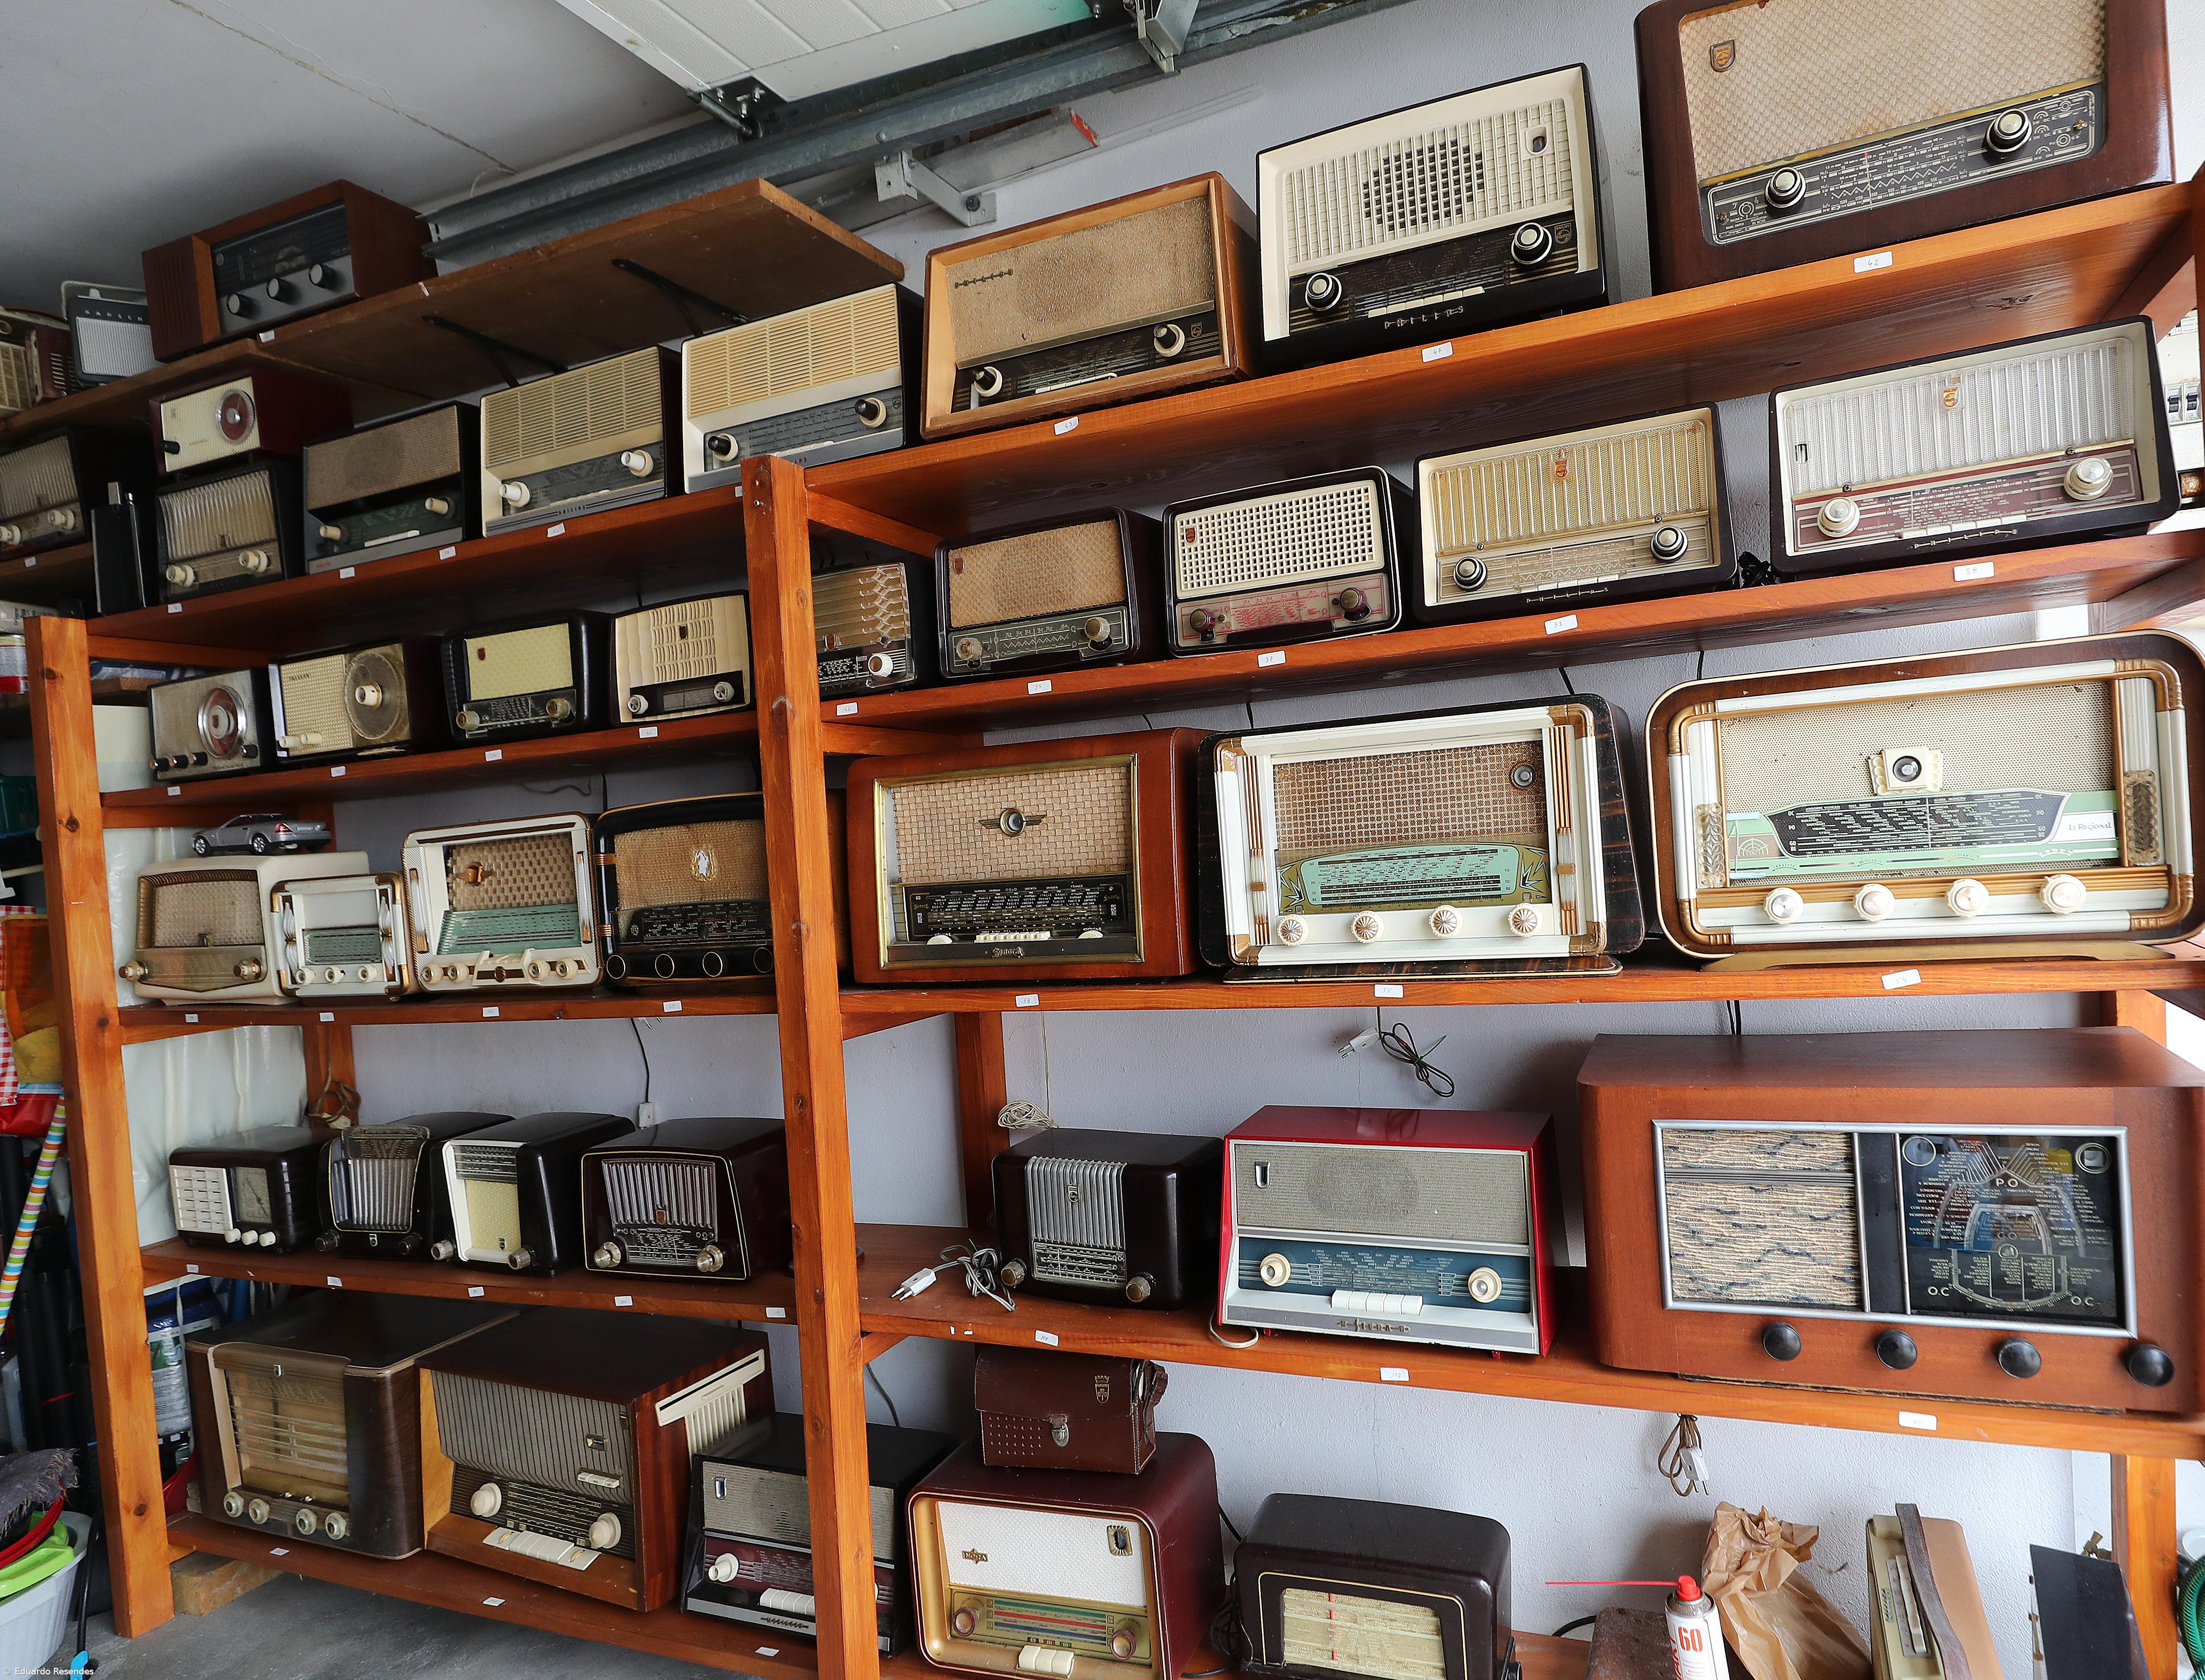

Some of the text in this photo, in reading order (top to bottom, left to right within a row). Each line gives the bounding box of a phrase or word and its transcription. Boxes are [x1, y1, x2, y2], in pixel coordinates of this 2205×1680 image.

[1384, 305, 1463, 329] PHILIPS
[558, 505, 586, 515] PHILIPS
[1914, 529, 2018, 549] PHILIPS
[1526, 587, 1608, 604] PHILIPS
[1678, 1627, 1703, 1652] 60
